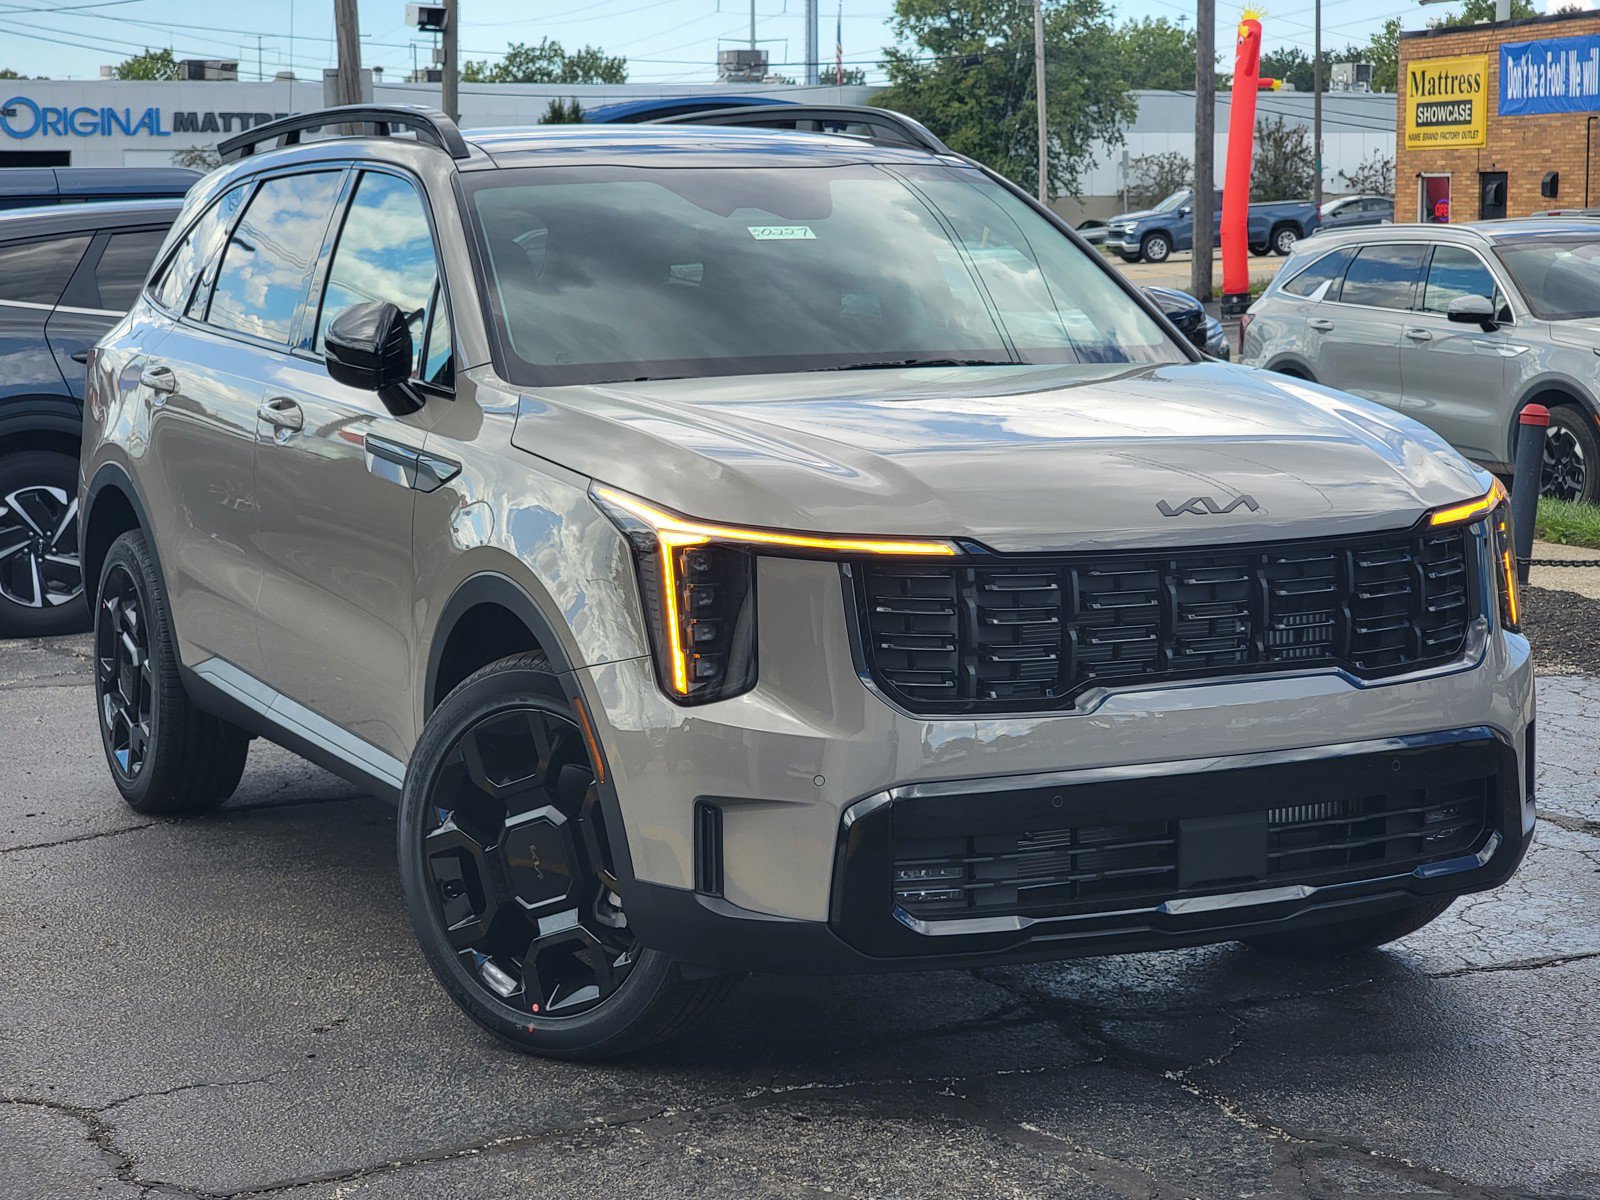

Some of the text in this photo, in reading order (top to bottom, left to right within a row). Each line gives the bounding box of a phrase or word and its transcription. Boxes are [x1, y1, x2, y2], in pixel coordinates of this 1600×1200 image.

[1410, 69, 1481, 97] Mattress
[1507, 53, 1527, 100] Don't
[1528, 53, 1538, 98] be
[1539, 63, 1545, 97] a
[1568, 49, 1581, 98] We
[1582, 47, 1600, 97] will
[0, 96, 322, 139] ORIGINAL MATTR
[1416, 104, 1472, 124] SHOWCASE
[1408, 130, 1479, 142] NAME BRAND FACTORY OUTLET
[1435, 203, 1450, 218] OPE
[1155, 494, 1260, 517] KIA
